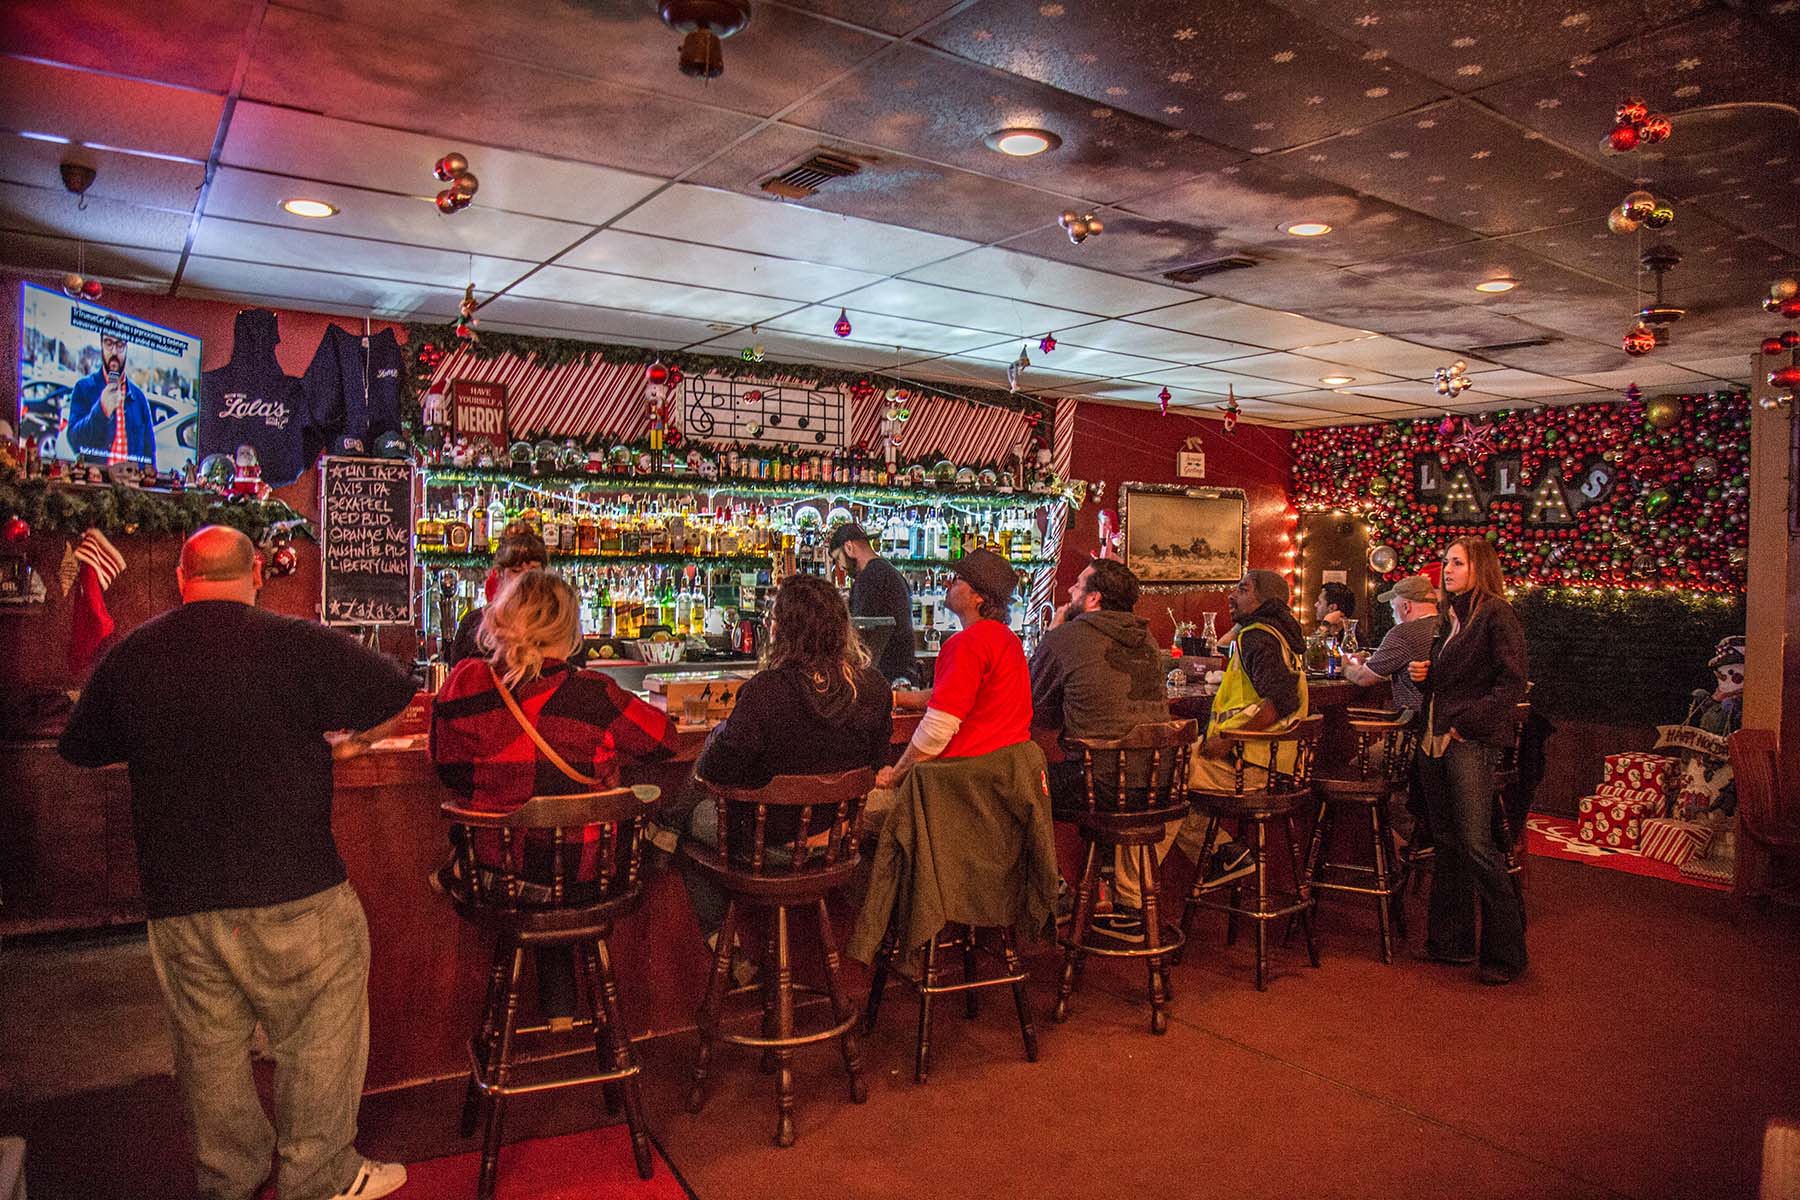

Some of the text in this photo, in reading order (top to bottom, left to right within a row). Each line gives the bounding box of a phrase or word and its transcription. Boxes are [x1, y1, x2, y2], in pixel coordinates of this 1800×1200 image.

[470, 386, 492, 397] HAVE
[218, 398, 290, 420] Lala's
[458, 395, 503, 408] YOURSELF A
[457, 405, 504, 434] MERRY
[369, 466, 397, 480] TAP
[332, 480, 391, 497] AXIS IPA
[331, 511, 391, 526] RED BUD
[386, 525, 408, 543] AVE
[385, 543, 407, 557] PILS
[331, 559, 381, 574] LIBERTY
